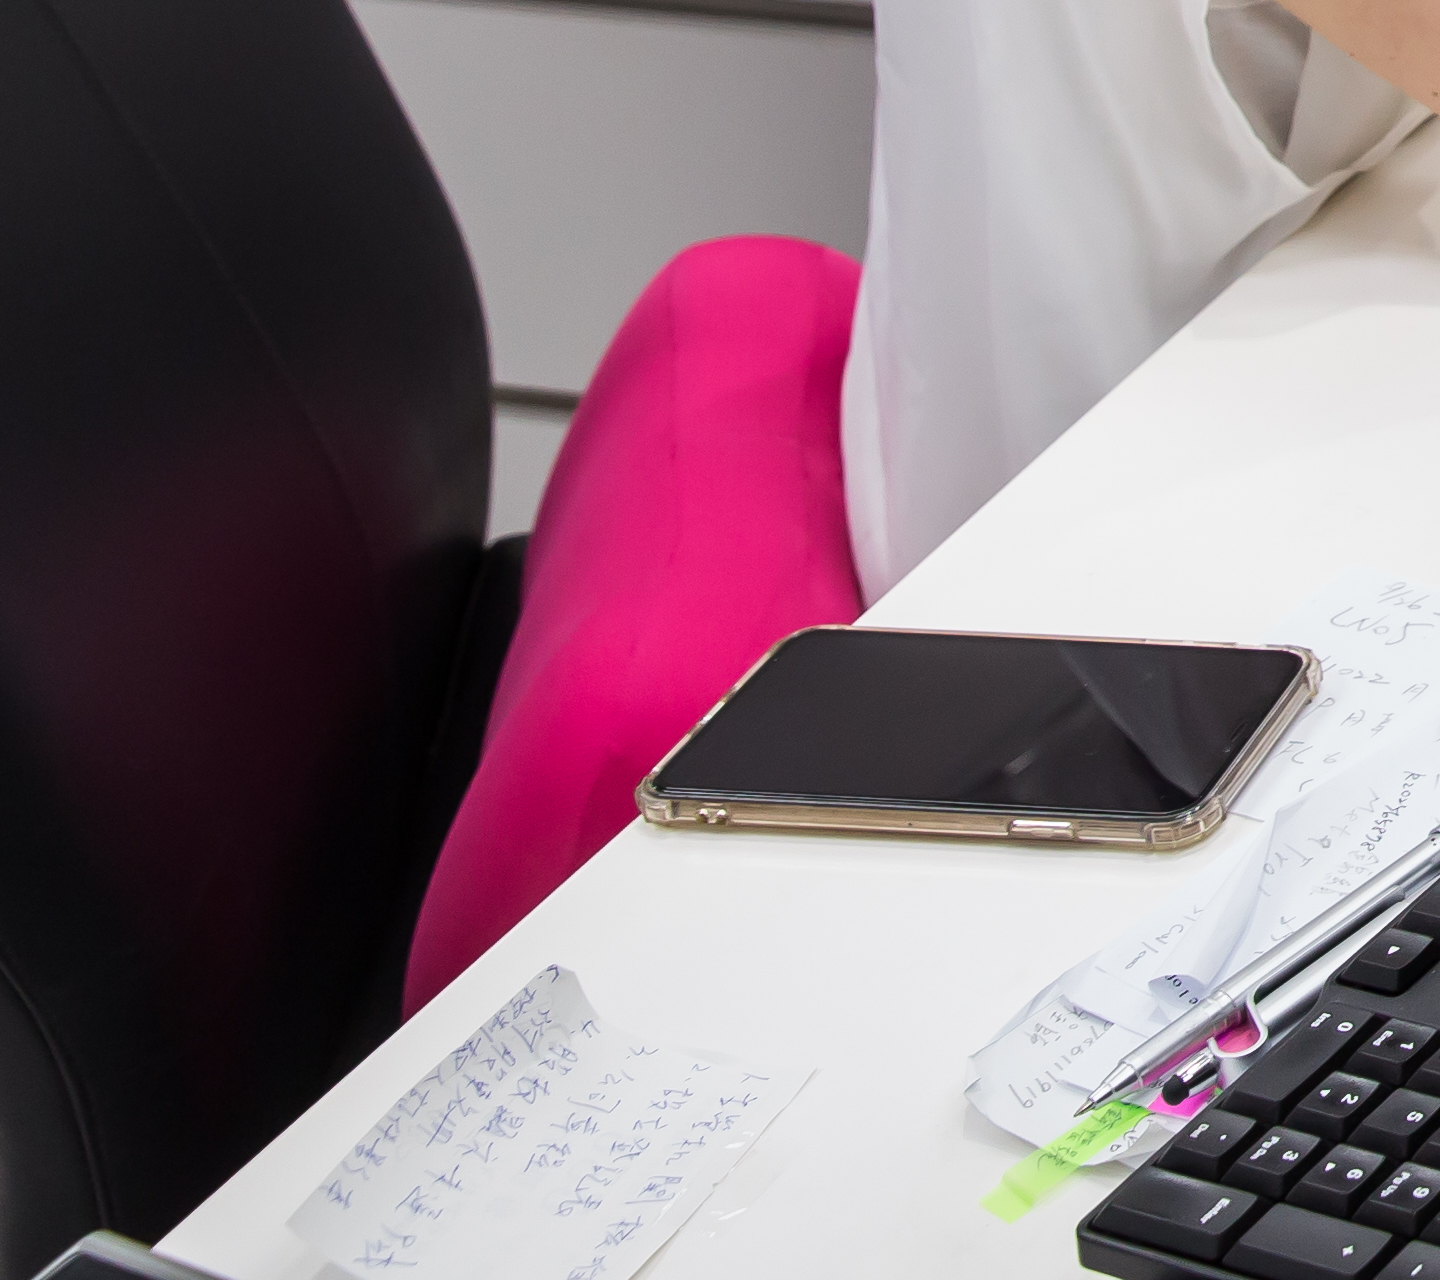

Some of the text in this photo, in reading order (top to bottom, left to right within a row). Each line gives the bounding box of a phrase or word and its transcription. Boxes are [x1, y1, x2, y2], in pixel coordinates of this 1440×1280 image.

[1340, 1093, 1359, 1105] 2
[1406, 1111, 1424, 1123] 5
[1281, 1150, 1299, 1162] 3
[1346, 1168, 1364, 1180] 6
[1412, 1186, 1430, 1199] 9
[1200, 1197, 1231, 1225] Enter
